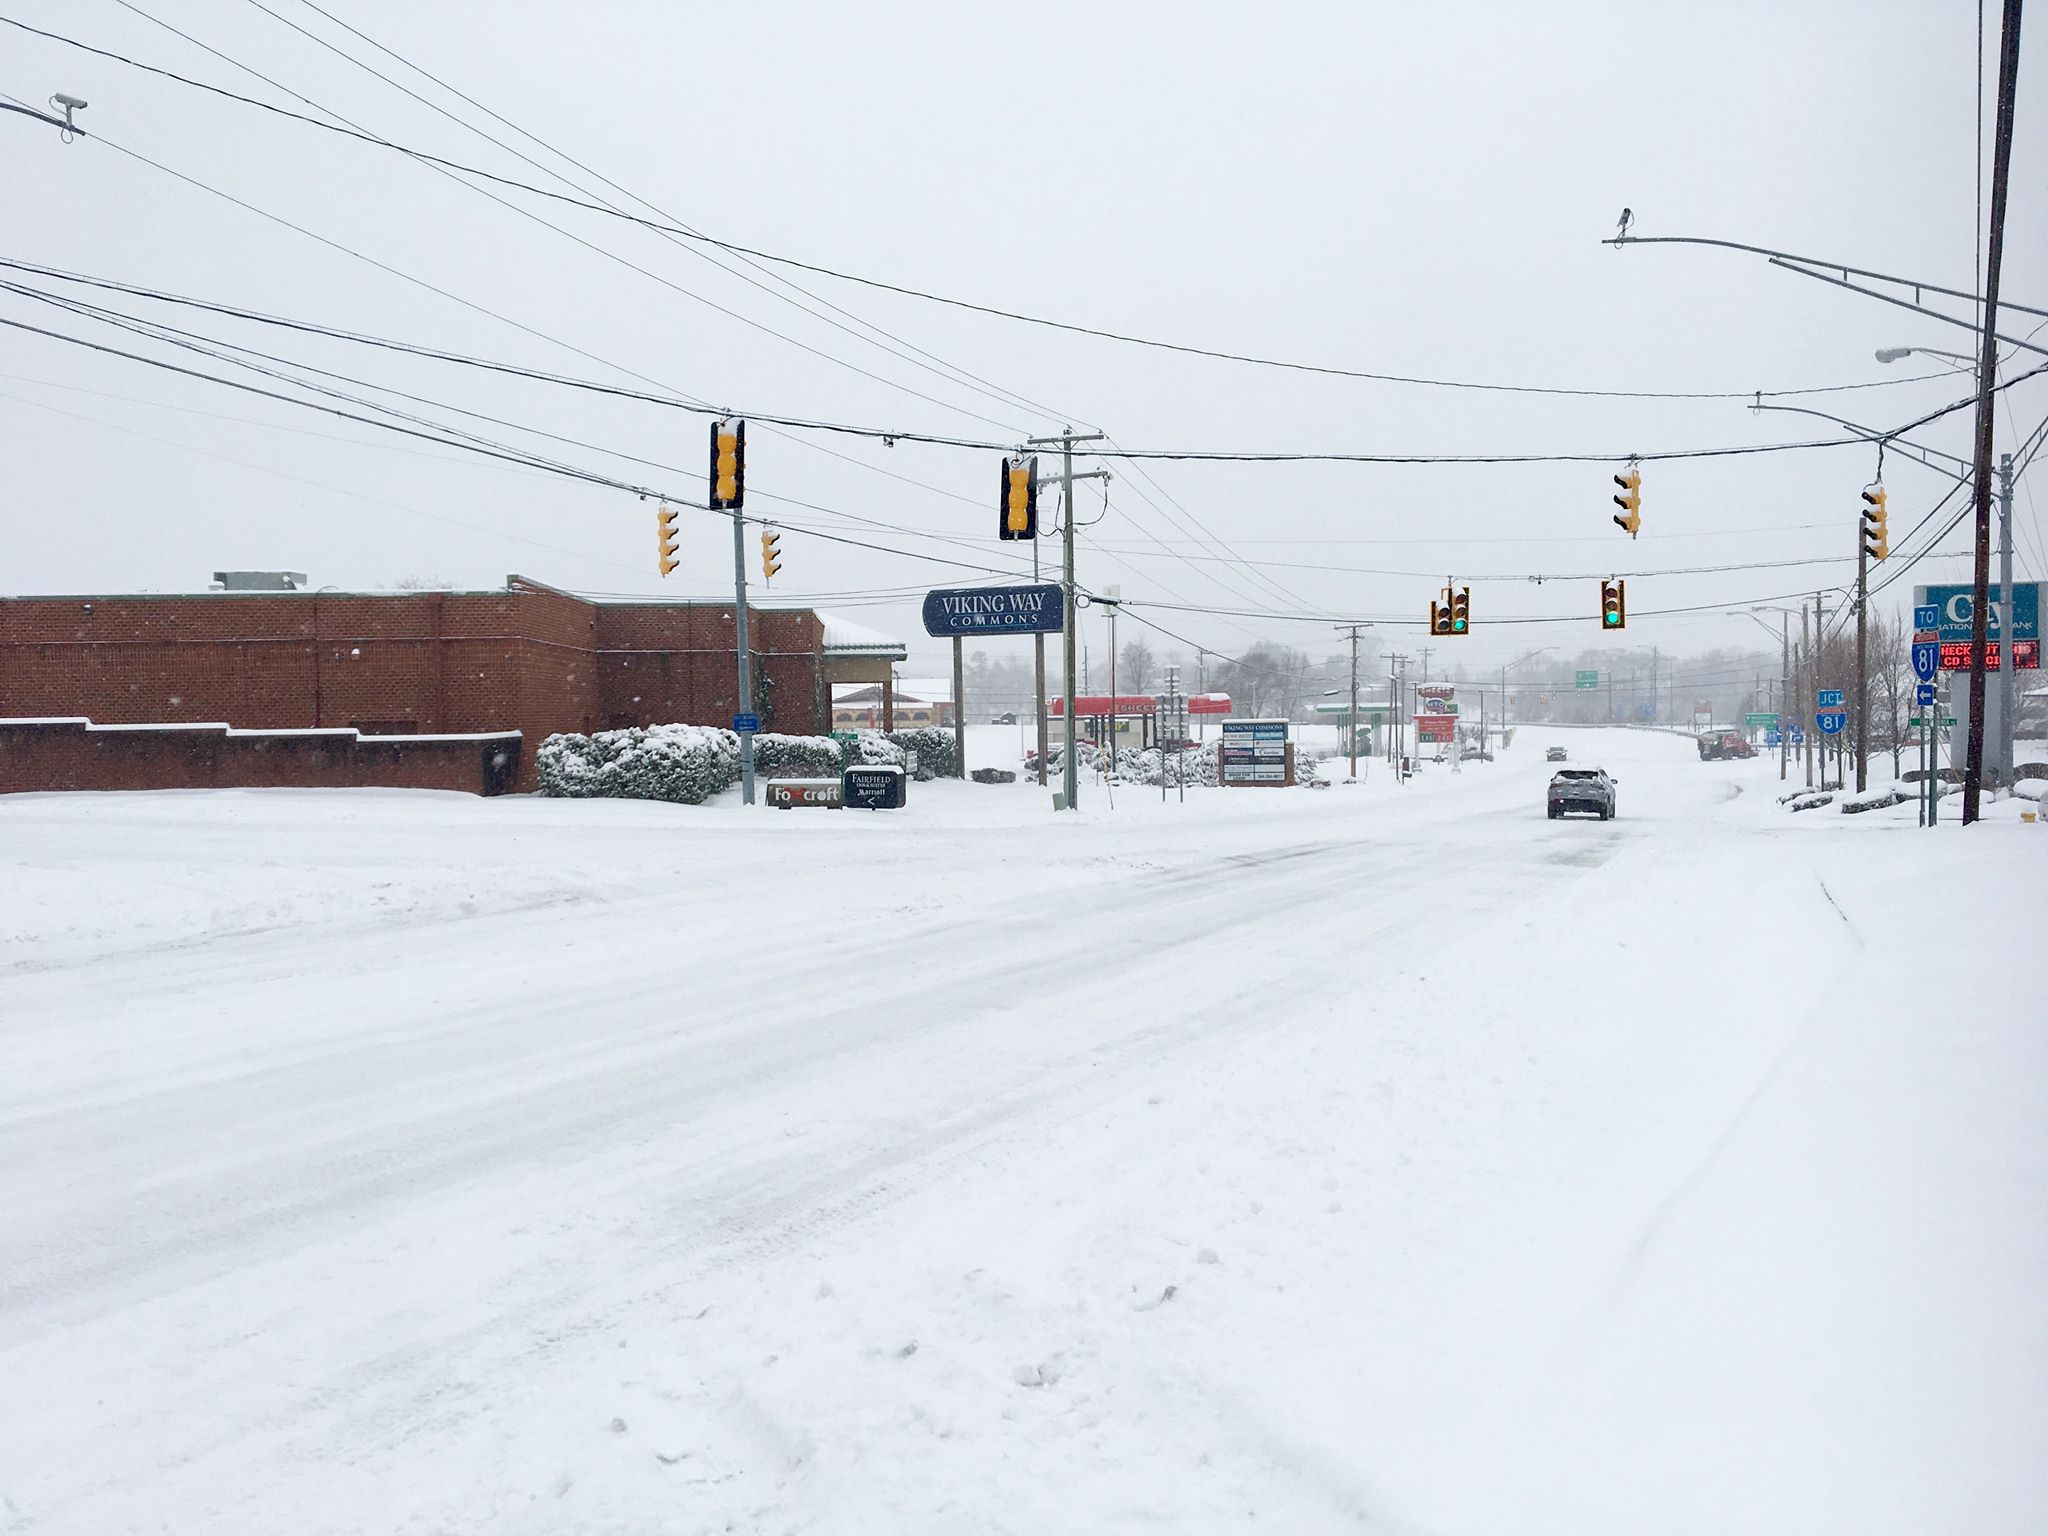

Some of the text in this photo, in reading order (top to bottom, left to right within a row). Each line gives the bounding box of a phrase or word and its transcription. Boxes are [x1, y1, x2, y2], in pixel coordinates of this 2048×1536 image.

[942, 592, 1046, 614] VIKING WAY
[950, 613, 1038, 626] COMMONS
[1919, 611, 1934, 623] TO
[2012, 621, 2033, 630] ANK
[1940, 646, 1972, 656] HECK
[1918, 649, 1934, 672] 81
[1821, 693, 1842, 704] JCT
[1823, 716, 1839, 729] 81
[852, 773, 891, 784] FAIRFIELD
[857, 788, 886, 796] Marriott
